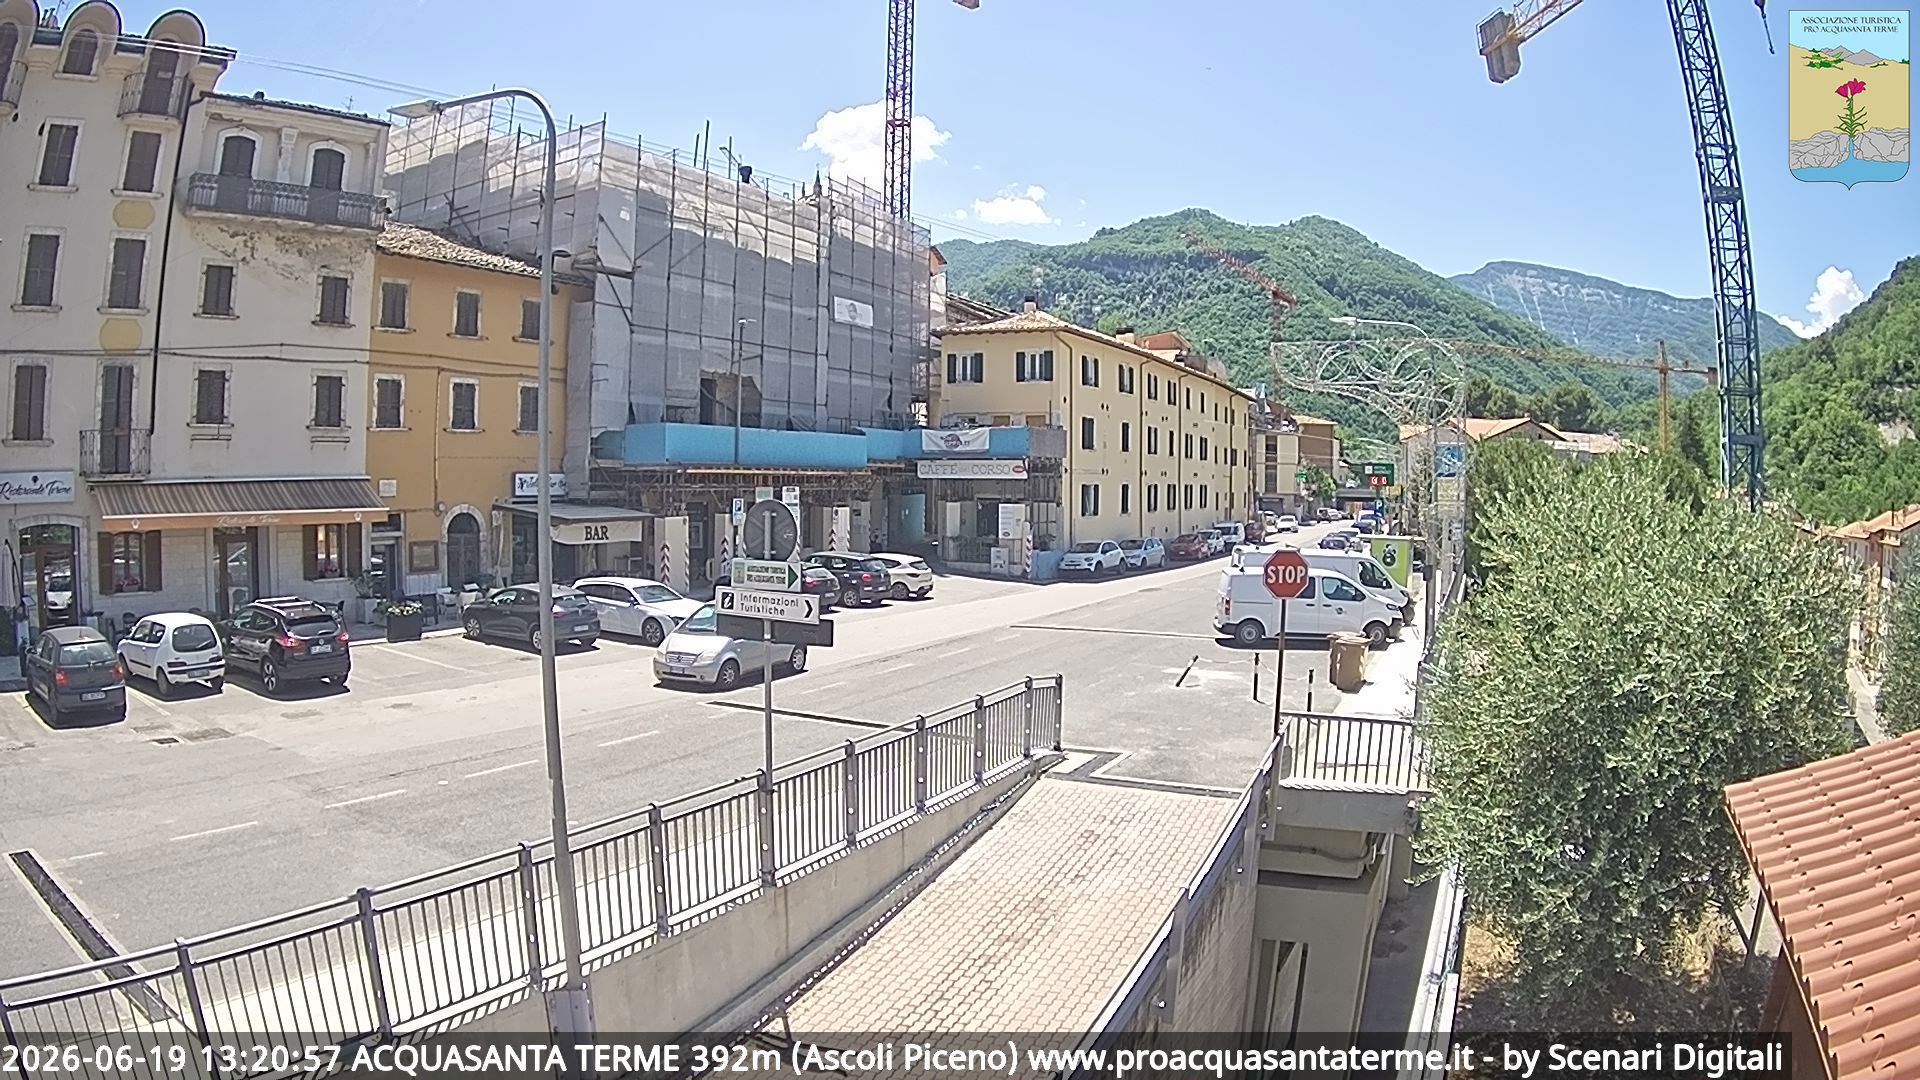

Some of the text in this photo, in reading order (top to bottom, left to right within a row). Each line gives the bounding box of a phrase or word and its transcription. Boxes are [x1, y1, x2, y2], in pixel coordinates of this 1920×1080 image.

[971, 464, 1011, 475] CORSO
[584, 525, 609, 541] BAR
[1266, 567, 1306, 584] STOP
[740, 593, 799, 607] Informazioni
